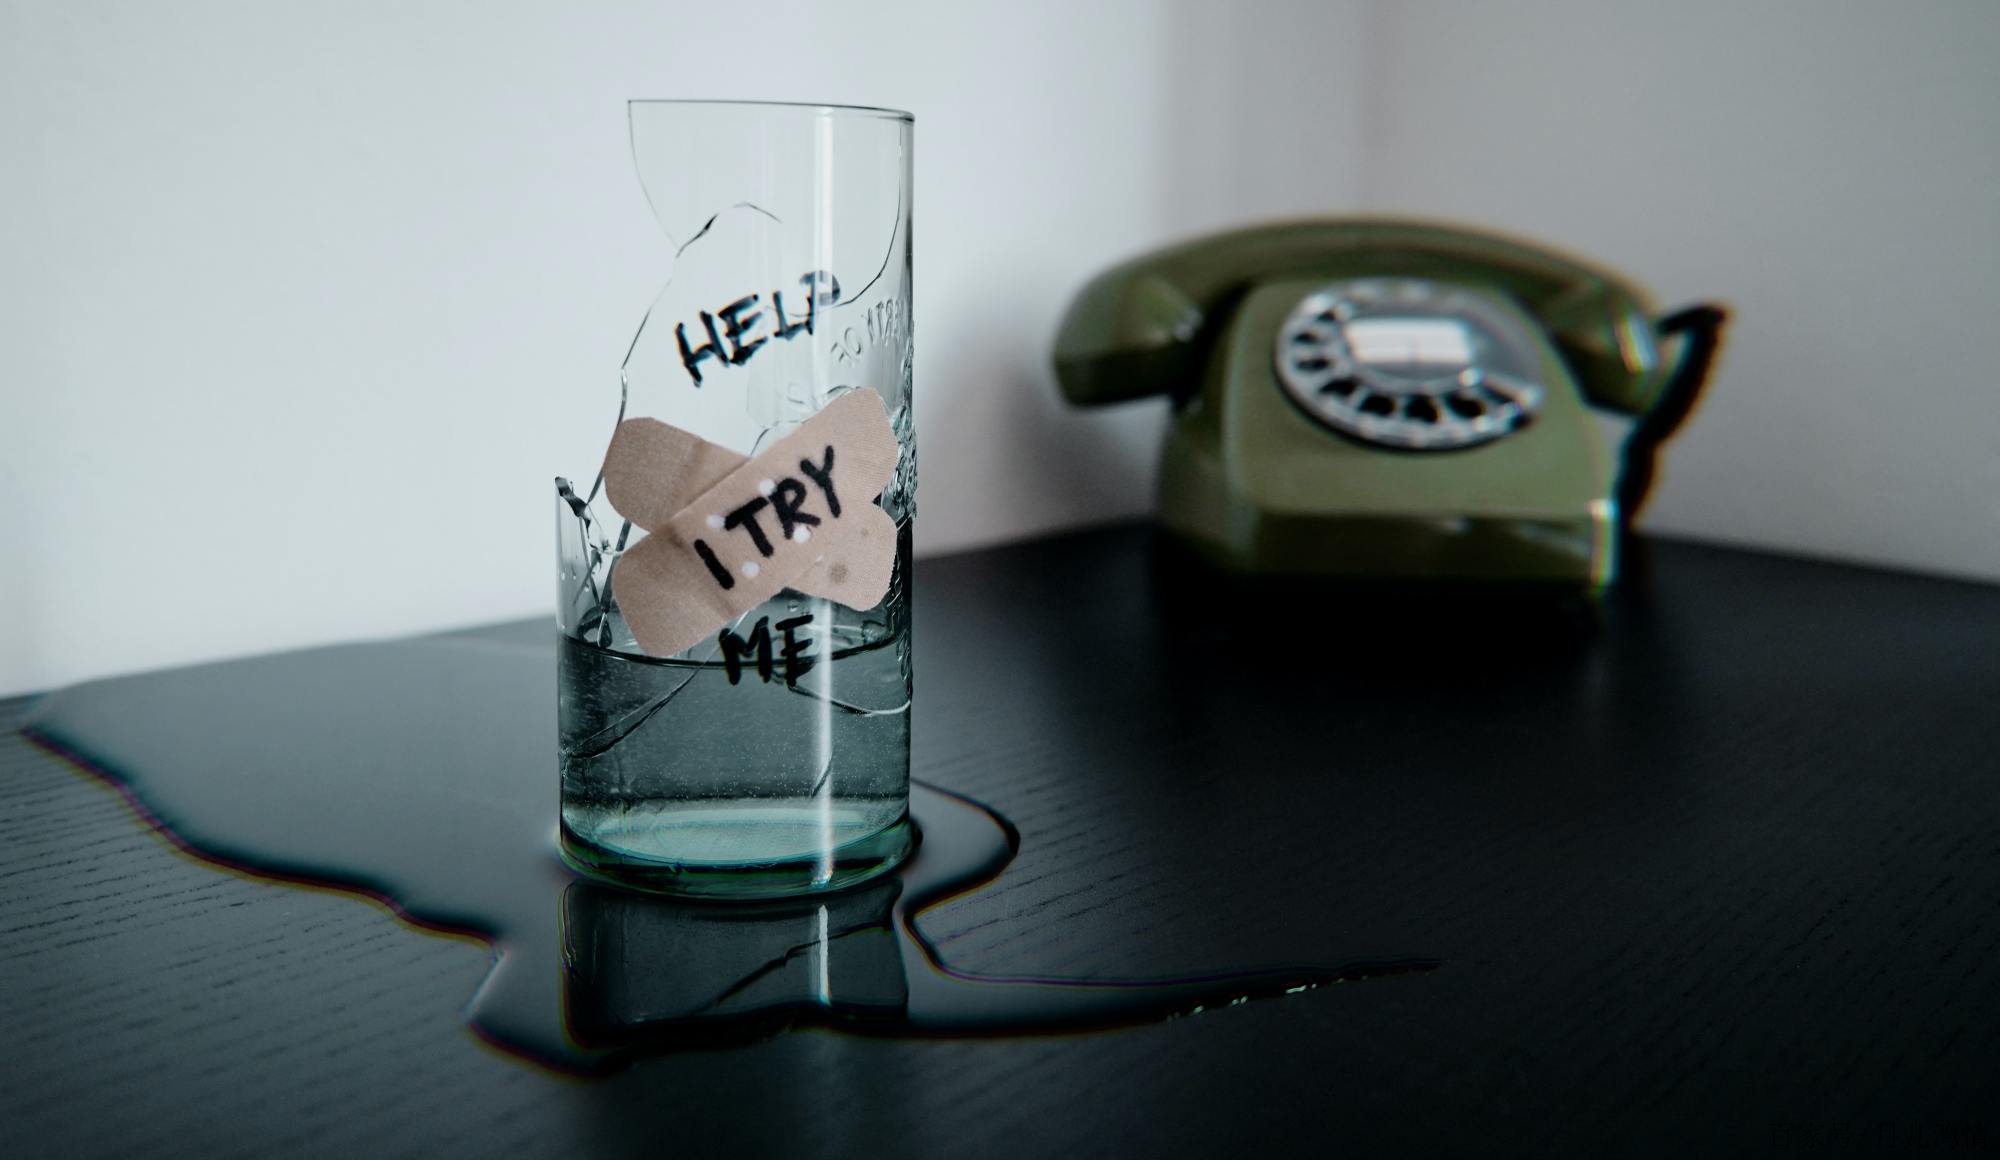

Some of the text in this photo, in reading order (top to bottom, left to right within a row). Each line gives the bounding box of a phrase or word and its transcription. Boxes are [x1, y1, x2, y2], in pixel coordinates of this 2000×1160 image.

[674, 270, 841, 386] HELP
[694, 445, 842, 590] I TRY
[718, 613, 815, 687] ME
